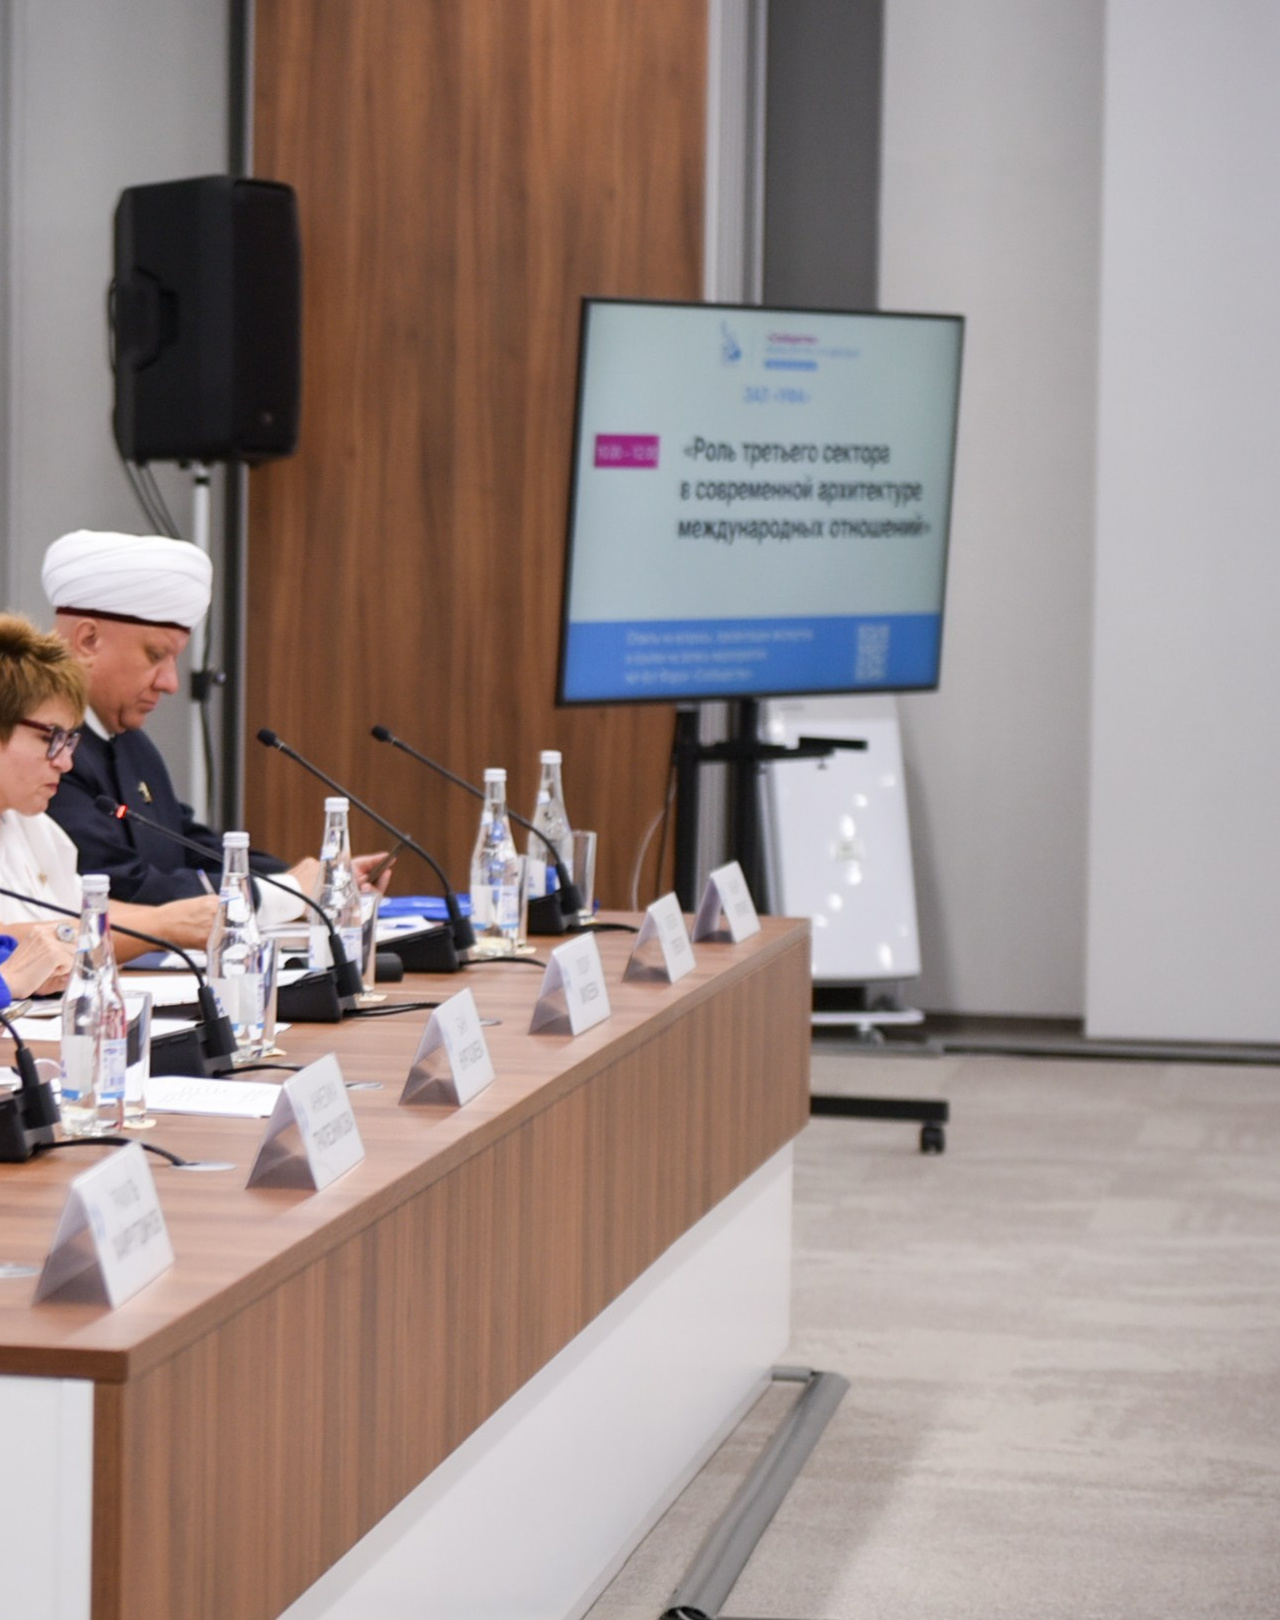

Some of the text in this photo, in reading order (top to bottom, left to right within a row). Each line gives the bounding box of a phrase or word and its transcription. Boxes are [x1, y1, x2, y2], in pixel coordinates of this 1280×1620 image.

[684, 435, 737, 463] «Роль
[741, 442, 818, 469] третьего
[822, 444, 891, 471] сектора
[680, 474, 923, 508] в современной архитектуре
[677, 511, 932, 546] международных отношений»
